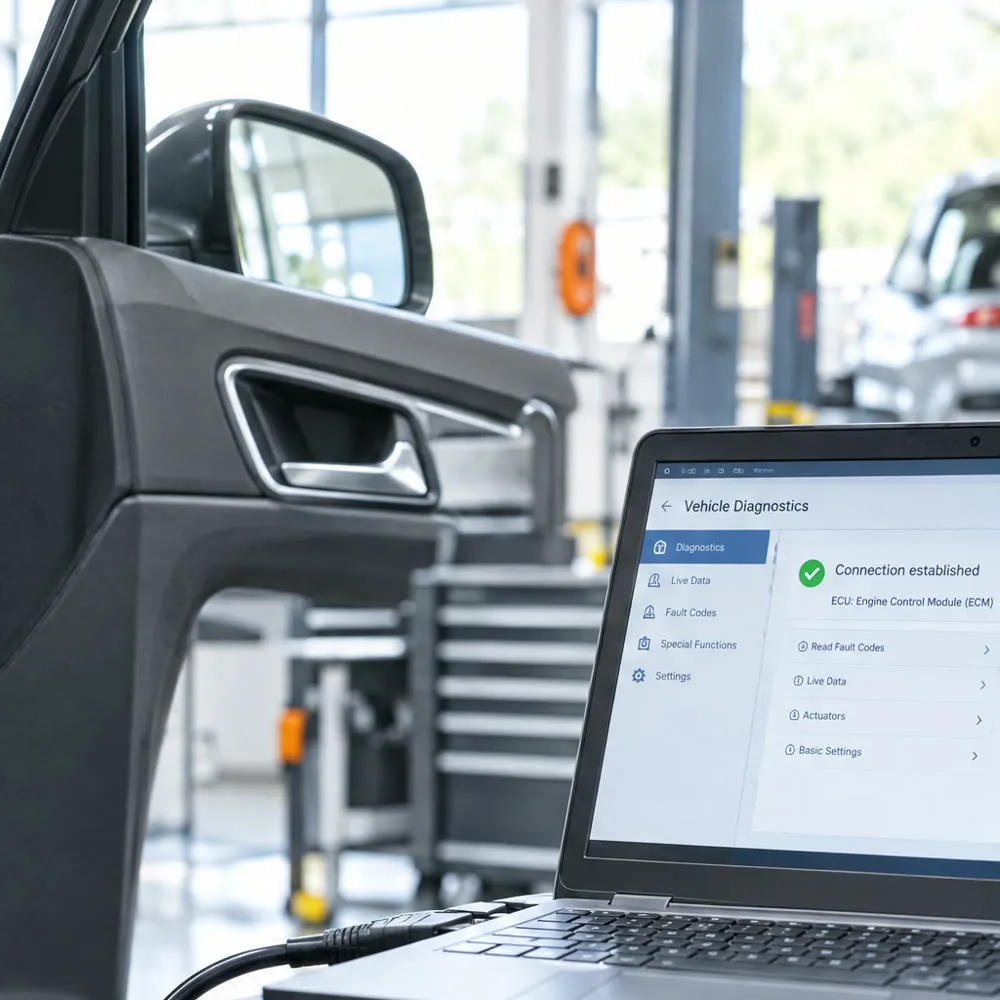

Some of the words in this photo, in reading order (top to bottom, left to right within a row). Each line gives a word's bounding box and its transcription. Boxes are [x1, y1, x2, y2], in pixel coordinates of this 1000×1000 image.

[684, 499, 730, 513] Vehicle
[733, 499, 809, 515] Diagnostics
[676, 542, 725, 553] Diagnostics
[835, 563, 905, 577] Connection
[909, 564, 980, 577] established
[671, 576, 689, 585] Live
[691, 576, 711, 585] Data
[831, 596, 854, 606] ECU:
[856, 596, 888, 607] Engine
[890, 597, 925, 606] Control
[927, 597, 962, 607] Module
[965, 598, 994, 609] (ECM)
[665, 608, 687, 617] Fault
[689, 608, 717, 617] Codes
[660, 639, 692, 650] Special
[694, 640, 737, 650] Functions
[811, 642, 833, 651] Read
[835, 643, 856, 652] Fault
[857, 643, 885, 652] Codes
[655, 671, 691, 683] Settings
[806, 676, 824, 686] Live
[826, 677, 847, 686] Data
[802, 711, 846, 721] Actuators
[799, 745, 823, 755] Basic
[825, 746, 862, 758] Settings
